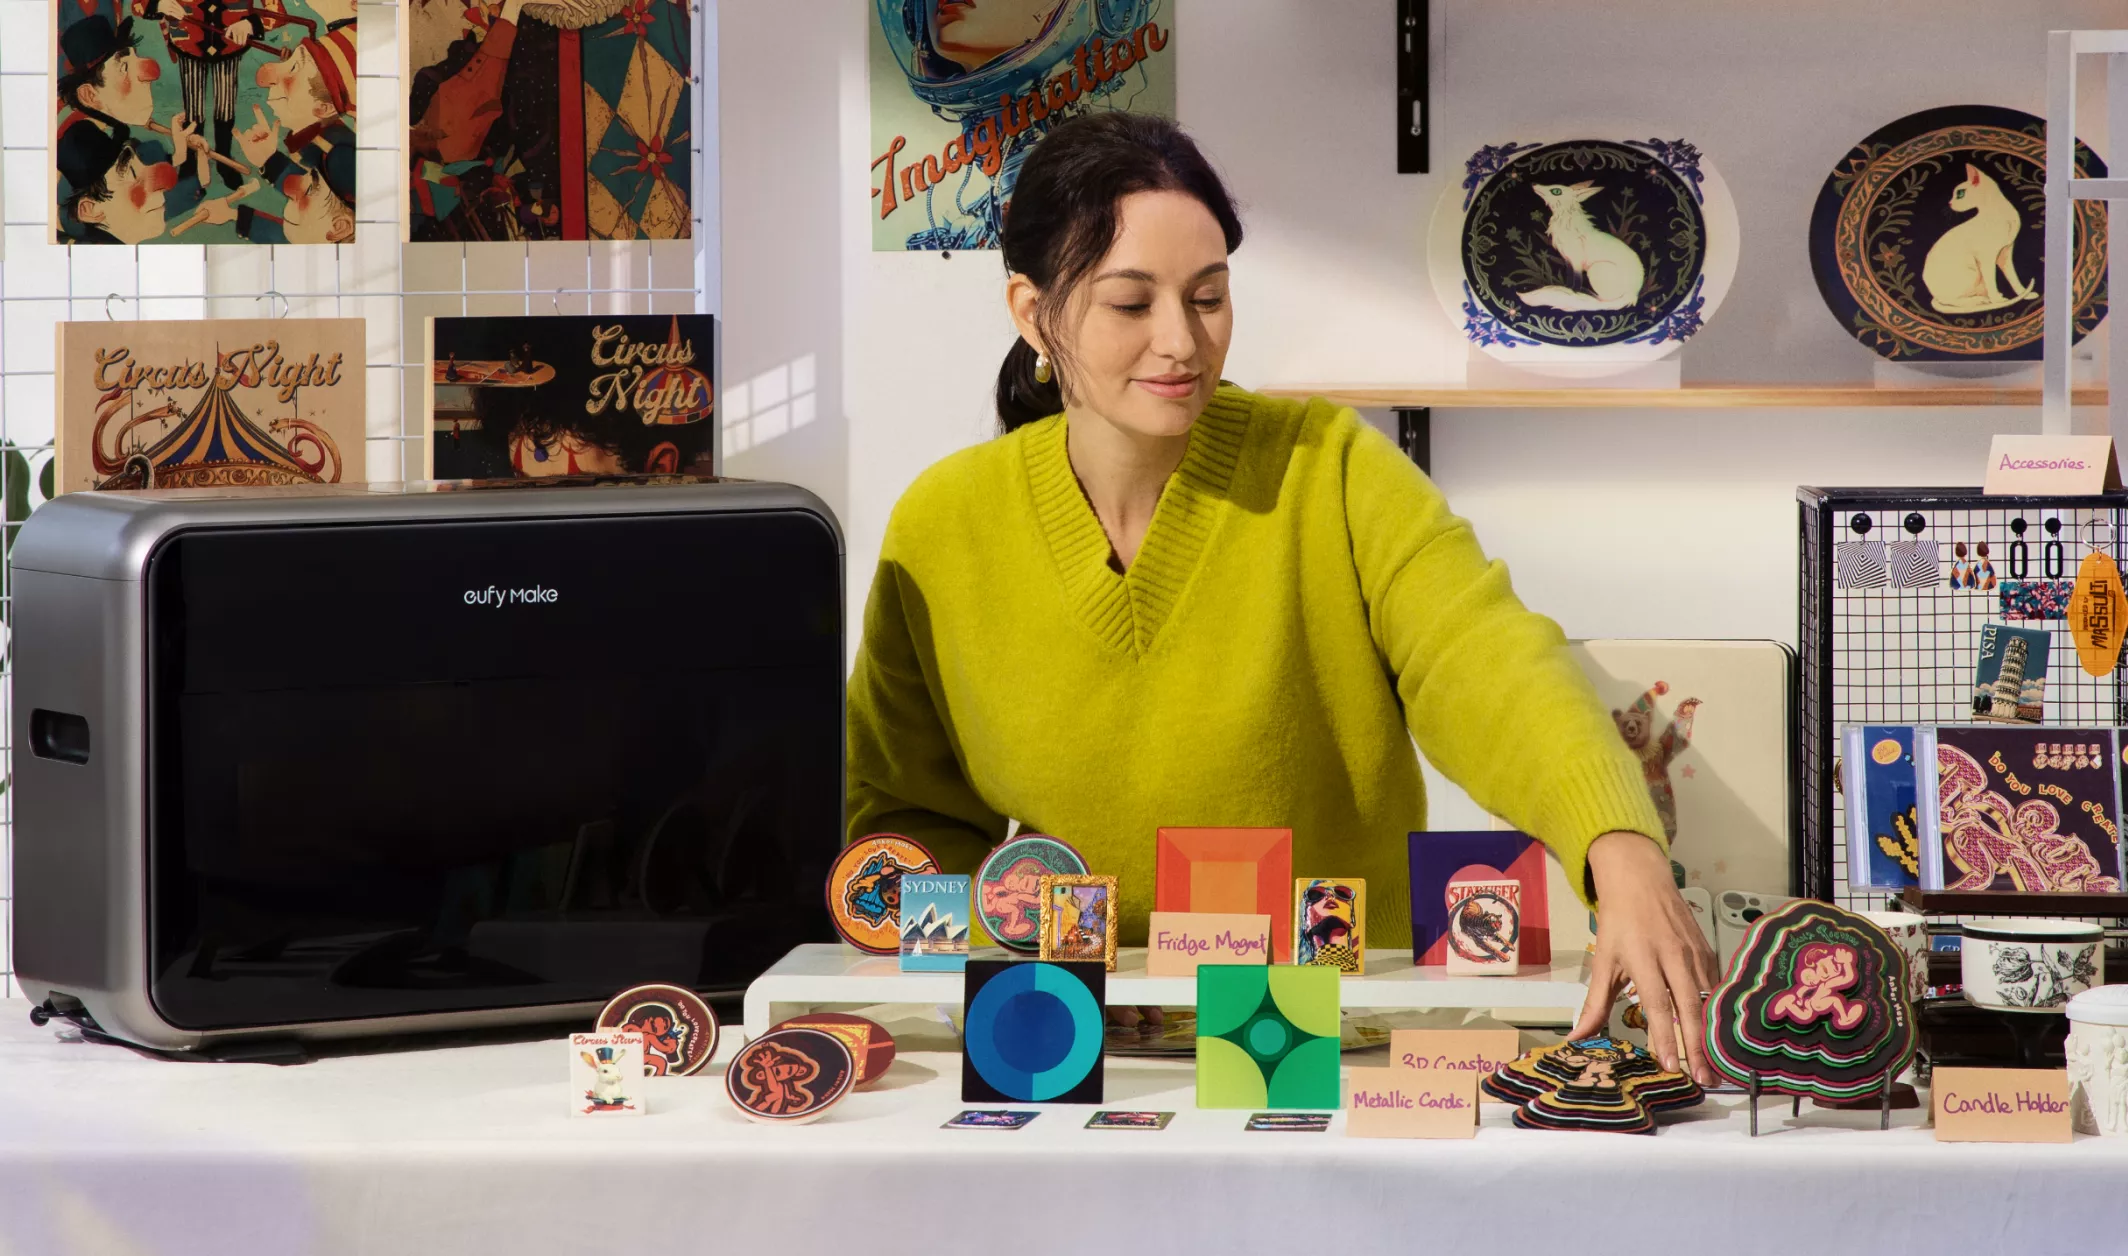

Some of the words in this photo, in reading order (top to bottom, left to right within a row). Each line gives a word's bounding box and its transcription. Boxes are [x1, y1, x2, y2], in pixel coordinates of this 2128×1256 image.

[871, 21, 1168, 220] Imagination
[591, 324, 696, 366] Circus
[93, 345, 210, 391] Circus
[214, 339, 343, 403] Night
[585, 364, 703, 425] Night
[463, 585, 507, 608] eufy
[510, 584, 558, 603] Make
[2089, 580, 2109, 649] MASSULTI
[1981, 626, 1997, 660] PISA
[2004, 772, 2031, 795] YOU
[2038, 783, 2073, 805] LOVE
[904, 881, 968, 893] SYDNEY
[1157, 931, 1210, 956] Fridge
[1215, 930, 1267, 956] Magnet
[1888, 975, 1898, 1002] Anker
[1354, 1090, 1414, 1109] Metallic
[1418, 1092, 1471, 1109] Cards.
[1943, 1092, 2014, 1114] Candle
[2016, 1091, 2069, 1114] Holder
